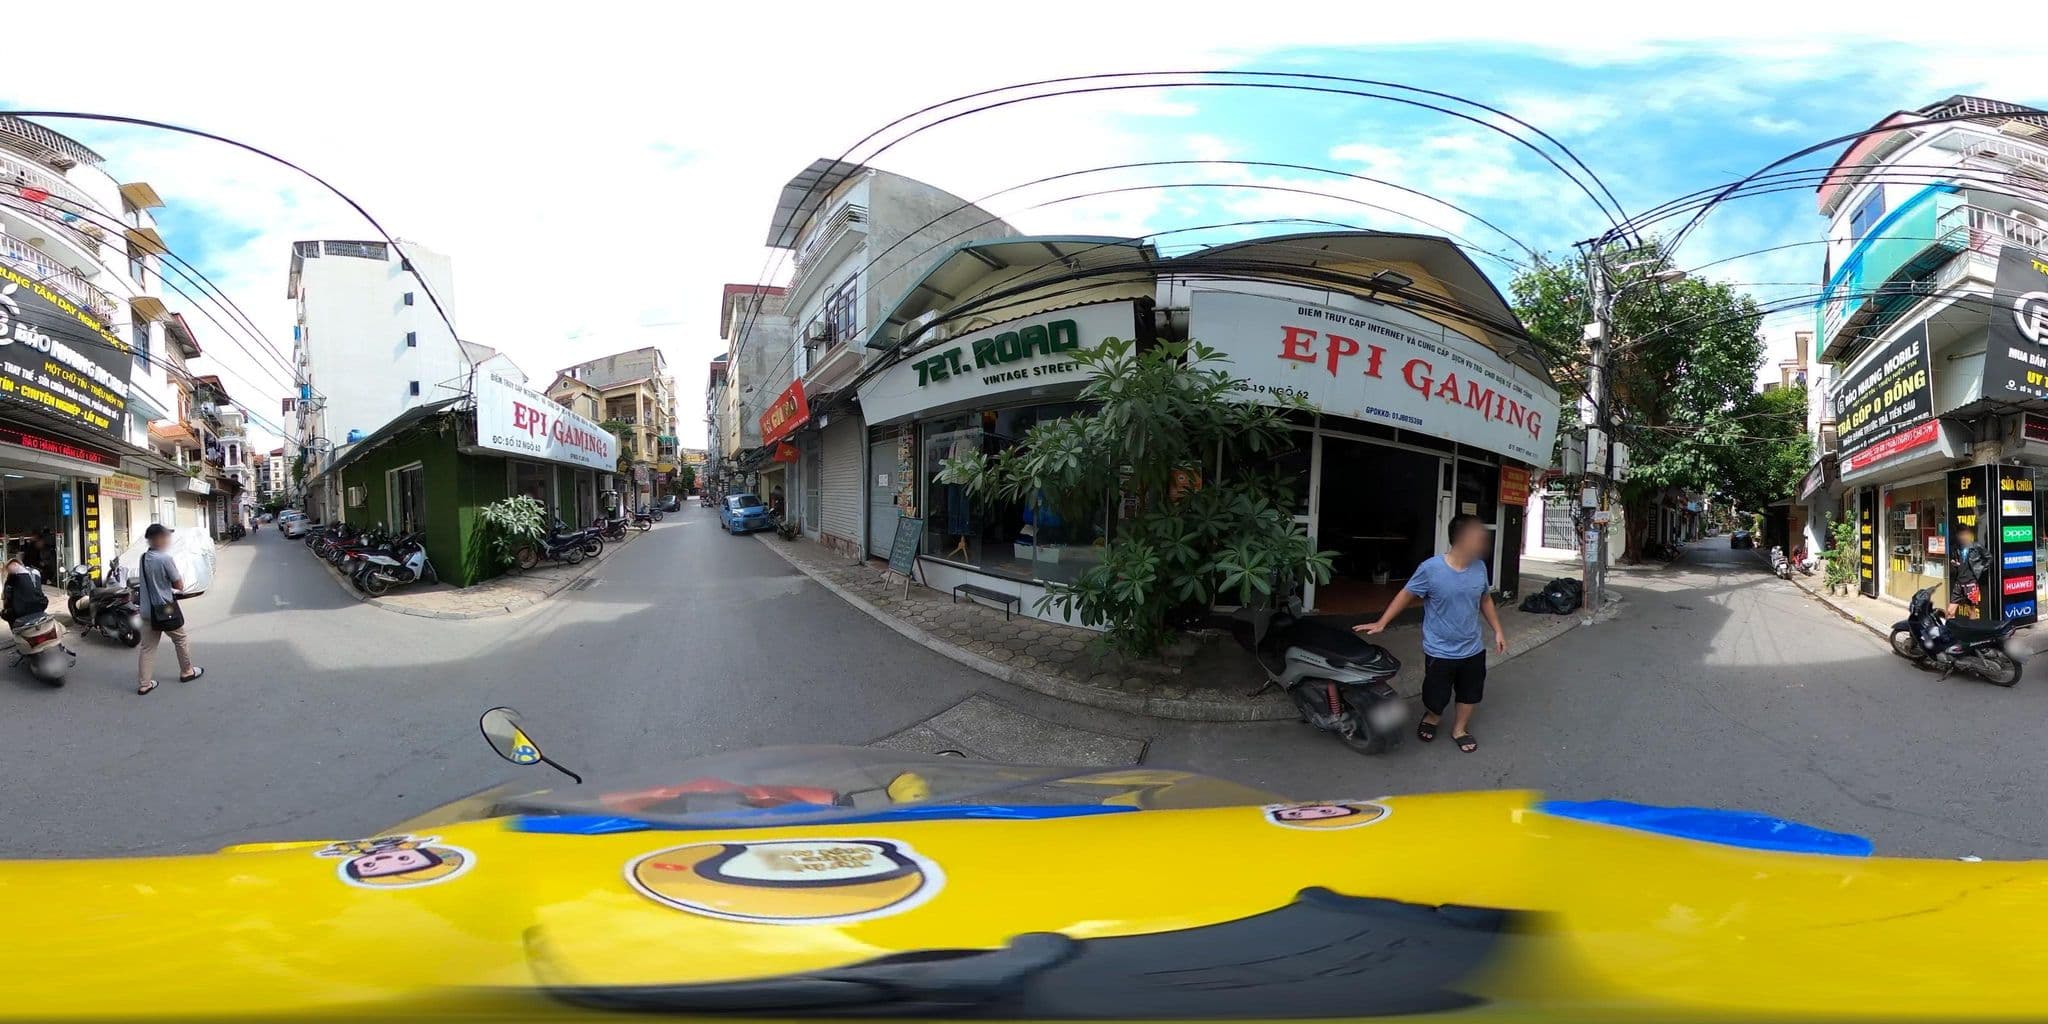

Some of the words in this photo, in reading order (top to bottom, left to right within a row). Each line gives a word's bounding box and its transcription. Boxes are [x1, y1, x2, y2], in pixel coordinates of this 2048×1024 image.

[33, 283, 57, 304] TÂM
[58, 299, 77, 316] DẠY
[1325, 312, 1347, 324] TRUY
[1367, 322, 1405, 341] INTERNET
[911, 347, 971, 387] 72T.
[971, 319, 1078, 369] ROAD
[2008, 347, 2028, 363] MUA
[2029, 352, 2047, 368] BÁN
[982, 368, 1028, 385] VINTAGE
[1033, 359, 1081, 377] STREET
[1858, 368, 1883, 396] NHUNG
[1883, 340, 1920, 377] MOBILE
[2026, 371, 2043, 386] UY
[1253, 384, 1266, 394] 19
[1268, 384, 1294, 397] NGÕ
[1277, 325, 1387, 379] EPI
[1401, 357, 1543, 441] GAMING
[1837, 413, 1852, 437] TRẢ
[1852, 401, 1872, 428] GÓP
[1883, 370, 1926, 408] ĐỒNG
[1902, 398, 1916, 414] SAU
[513, 401, 548, 439] EPI
[2006, 580, 2032, 590] HUAWEI
[2005, 606, 2032, 618] vivo
